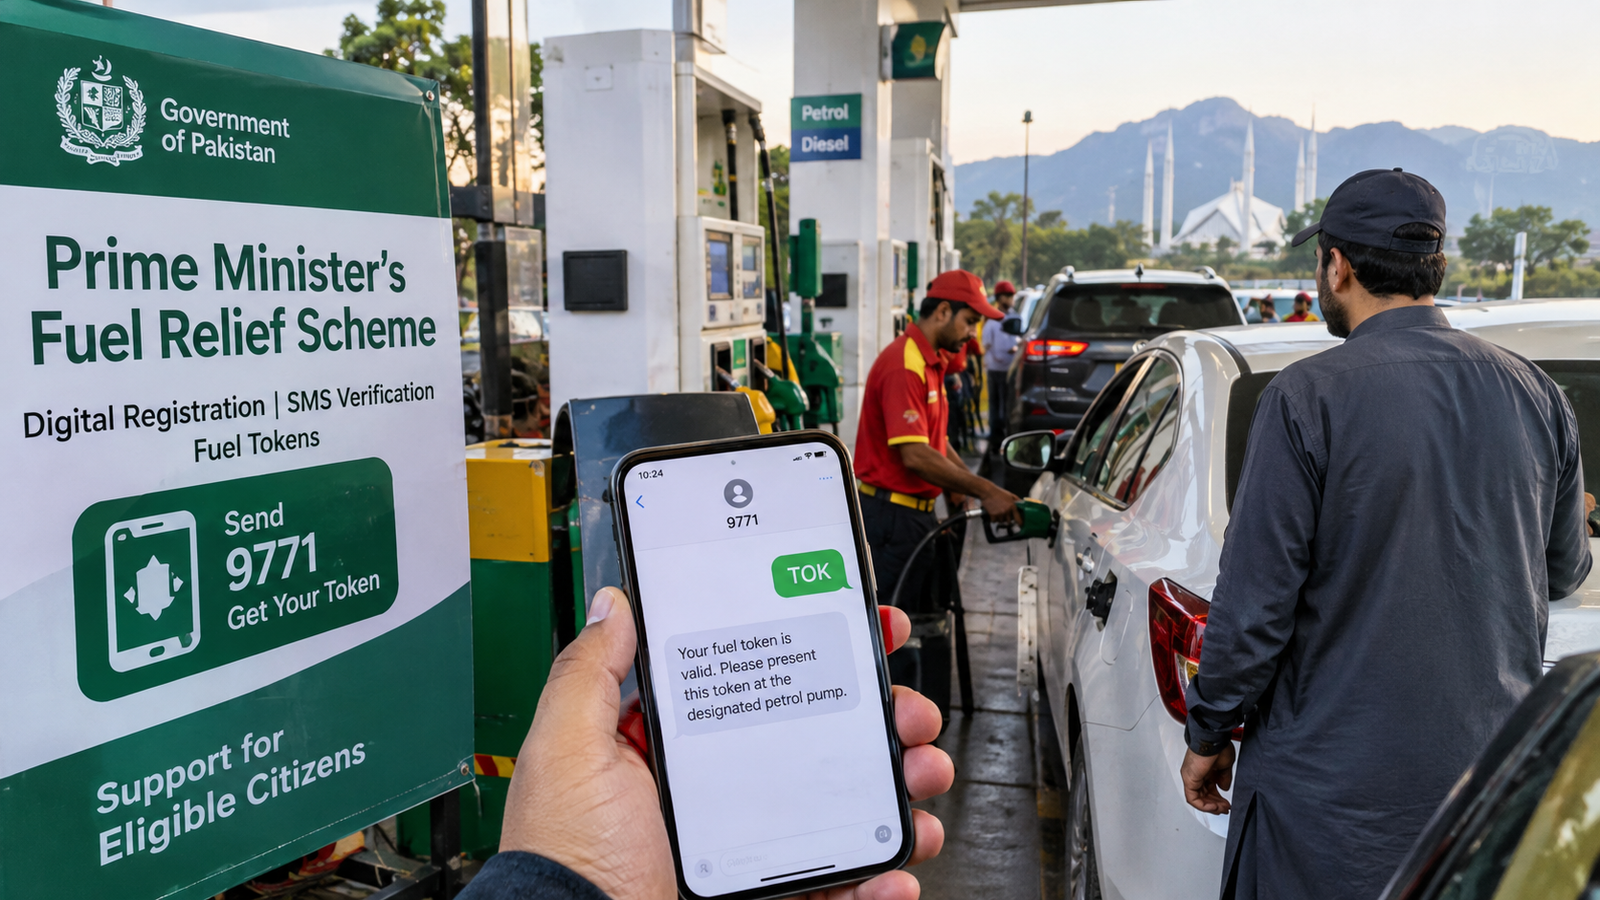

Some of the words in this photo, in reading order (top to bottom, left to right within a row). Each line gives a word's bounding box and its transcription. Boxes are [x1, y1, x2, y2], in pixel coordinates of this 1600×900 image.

[160, 97, 290, 139] Government
[801, 103, 849, 122] Petrol
[161, 129, 186, 153] of
[191, 131, 276, 164] Pakistan
[801, 134, 849, 153] Diesel
[46, 236, 198, 291] Prime
[32, 308, 142, 365] Fuel
[160, 307, 285, 358] Relief
[298, 306, 436, 352] Scheme
[24, 405, 114, 442] Digital
[124, 395, 264, 432] Registration
[288, 389, 331, 412] SMS
[337, 382, 434, 407] Verification
[195, 435, 240, 462] Fuel
[248, 430, 319, 454] Tokens
[638, 469, 664, 480] 10:24
[225, 502, 283, 535] Send
[726, 513, 759, 529] 9771
[226, 532, 318, 592] 9771
[786, 562, 832, 584] TOK
[228, 601, 268, 629] Get
[273, 590, 319, 616] Your
[324, 574, 379, 602] Token
[677, 646, 709, 660] Your
[712, 639, 738, 655] fuel
[740, 636, 778, 651] token
[780, 632, 792, 645] is
[680, 664, 717, 681] valid.
[719, 659, 764, 675] Please
[766, 649, 817, 671] present
[683, 686, 710, 701] this
[712, 681, 751, 697] token
[753, 677, 768, 690] at
[769, 673, 792, 688] the
[687, 699, 762, 722] designated
[764, 690, 803, 712] petrol
[806, 687, 847, 705] pump.
[96, 744, 232, 814] Support
[241, 730, 283, 763] for
[99, 790, 236, 866] Eligible
[246, 742, 366, 805] Citizens
